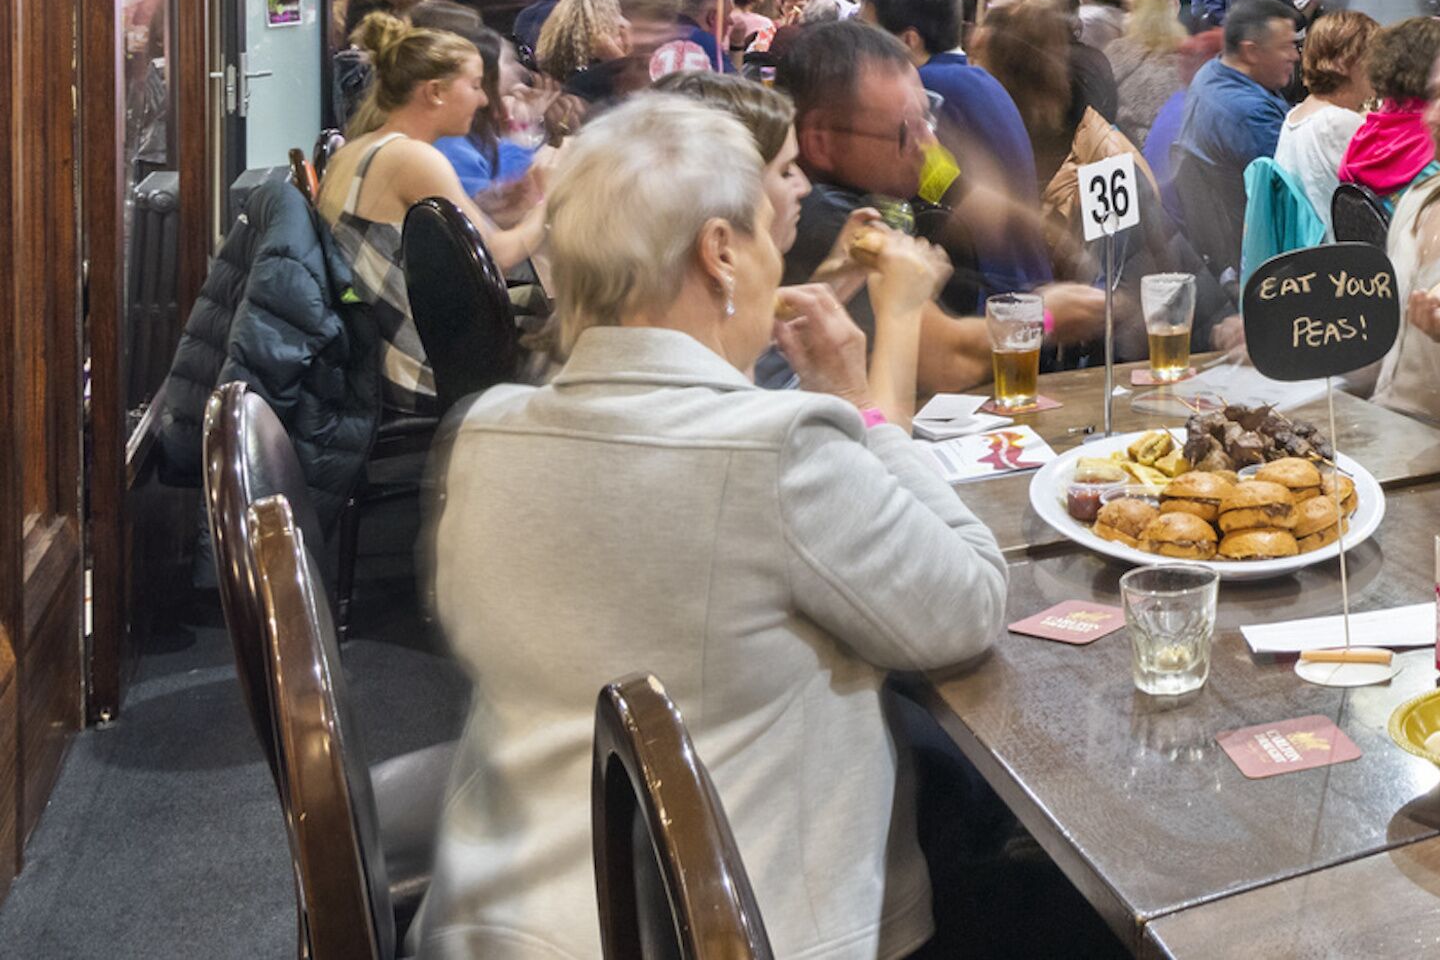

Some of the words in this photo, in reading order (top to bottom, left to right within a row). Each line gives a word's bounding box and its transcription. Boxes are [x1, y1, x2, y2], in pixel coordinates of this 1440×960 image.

[1089, 168, 1129, 224] 36
[1259, 271, 1317, 300] EAT
[1328, 270, 1393, 299] YOUR
[1292, 314, 1368, 348] PEAS!
